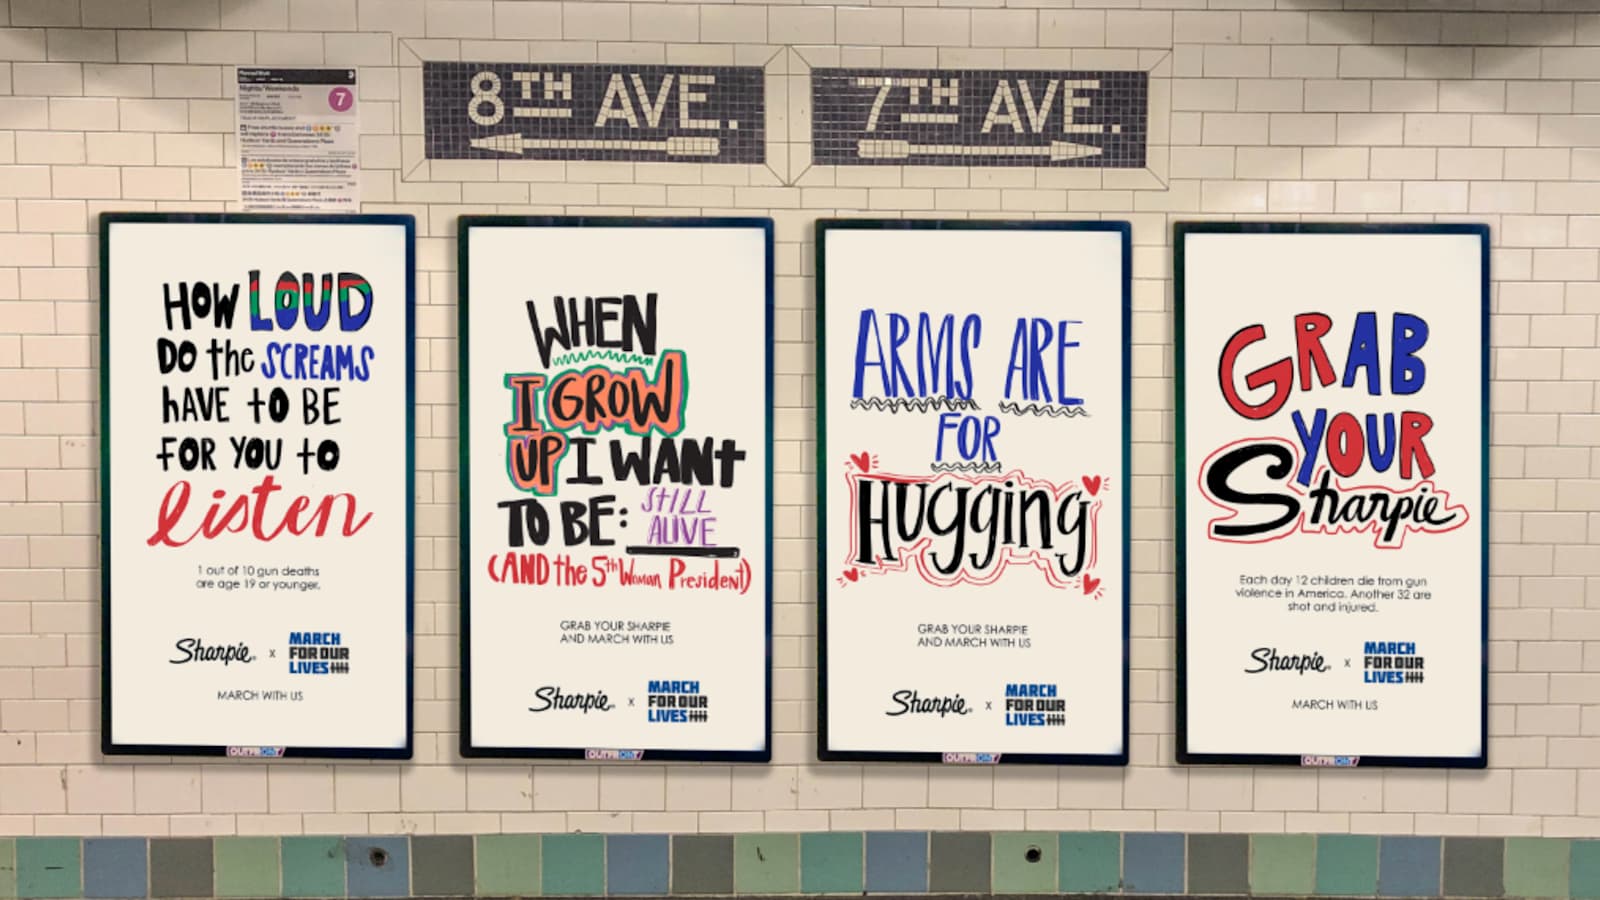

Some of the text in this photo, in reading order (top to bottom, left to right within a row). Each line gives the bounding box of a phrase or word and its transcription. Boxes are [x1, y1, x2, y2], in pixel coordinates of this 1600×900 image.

[335, 92, 346, 106] 7
[467, 71, 738, 130] 8TH AVE.
[856, 77, 1121, 134] 7TH AVE.
[162, 269, 374, 332] HOW LOUD
[526, 292, 658, 369] WHEN
[156, 337, 375, 382] DO the SCREAMS
[850, 306, 1086, 405] ARMS ARE
[1216, 310, 1431, 421] GRAB
[512, 358, 674, 432] I GROW
[302, 387, 341, 426] BE
[933, 411, 1002, 462] FOR
[156, 436, 217, 472] FOR
[229, 436, 283, 471] YOU
[1291, 408, 1436, 488] YOUR
[515, 439, 563, 486] UP
[566, 438, 603, 485] I
[1206, 443, 1457, 542] Sharpie
[146, 476, 374, 547] listen
[497, 494, 629, 547] TO BE:
[647, 514, 717, 546] ALIVE
[198, 565, 320, 578] 1 out of 10 gun deaths
[488, 552, 550, 585] (AND
[553, 554, 588, 586] the
[195, 578, 321, 592] are age 19 or younger.
[1239, 574, 1428, 587] Each day 12 children die from gun
[1235, 587, 1432, 600] violence in America. Another 32 are
[1287, 601, 1378, 614] shot and injured.
[559, 620, 671, 632] GRAB YOUR SHARPIE
[917, 623, 1028, 635] GRAB YOUR SHARPIE
[288, 632, 341, 646] MARCH
[559, 632, 674, 645] AND MARCH WITH US
[917, 636, 1032, 649] AND MARCH WITH US
[169, 638, 252, 666] Sharpie
[289, 646, 349, 660] FOR OUR
[1364, 641, 1416, 655] MARCH
[289, 661, 329, 675] LIVES
[1244, 648, 1326, 676] Sharpie
[1364, 656, 1424, 670] FOR OUR
[1364, 670, 1404, 684] LIVES
[648, 680, 700, 694] MARCH
[1005, 683, 1057, 698] MARCH
[217, 689, 304, 702] MARCH WITH US
[528, 686, 611, 714] Sharpie
[648, 695, 708, 709] FOR OUR
[885, 690, 968, 718] Sharpie
[1005, 699, 1066, 713] FOR OUR
[1291, 699, 1379, 711] MARCH WITH US
[648, 709, 688, 723] LIVES
[1005, 713, 1046, 726] LIVES
